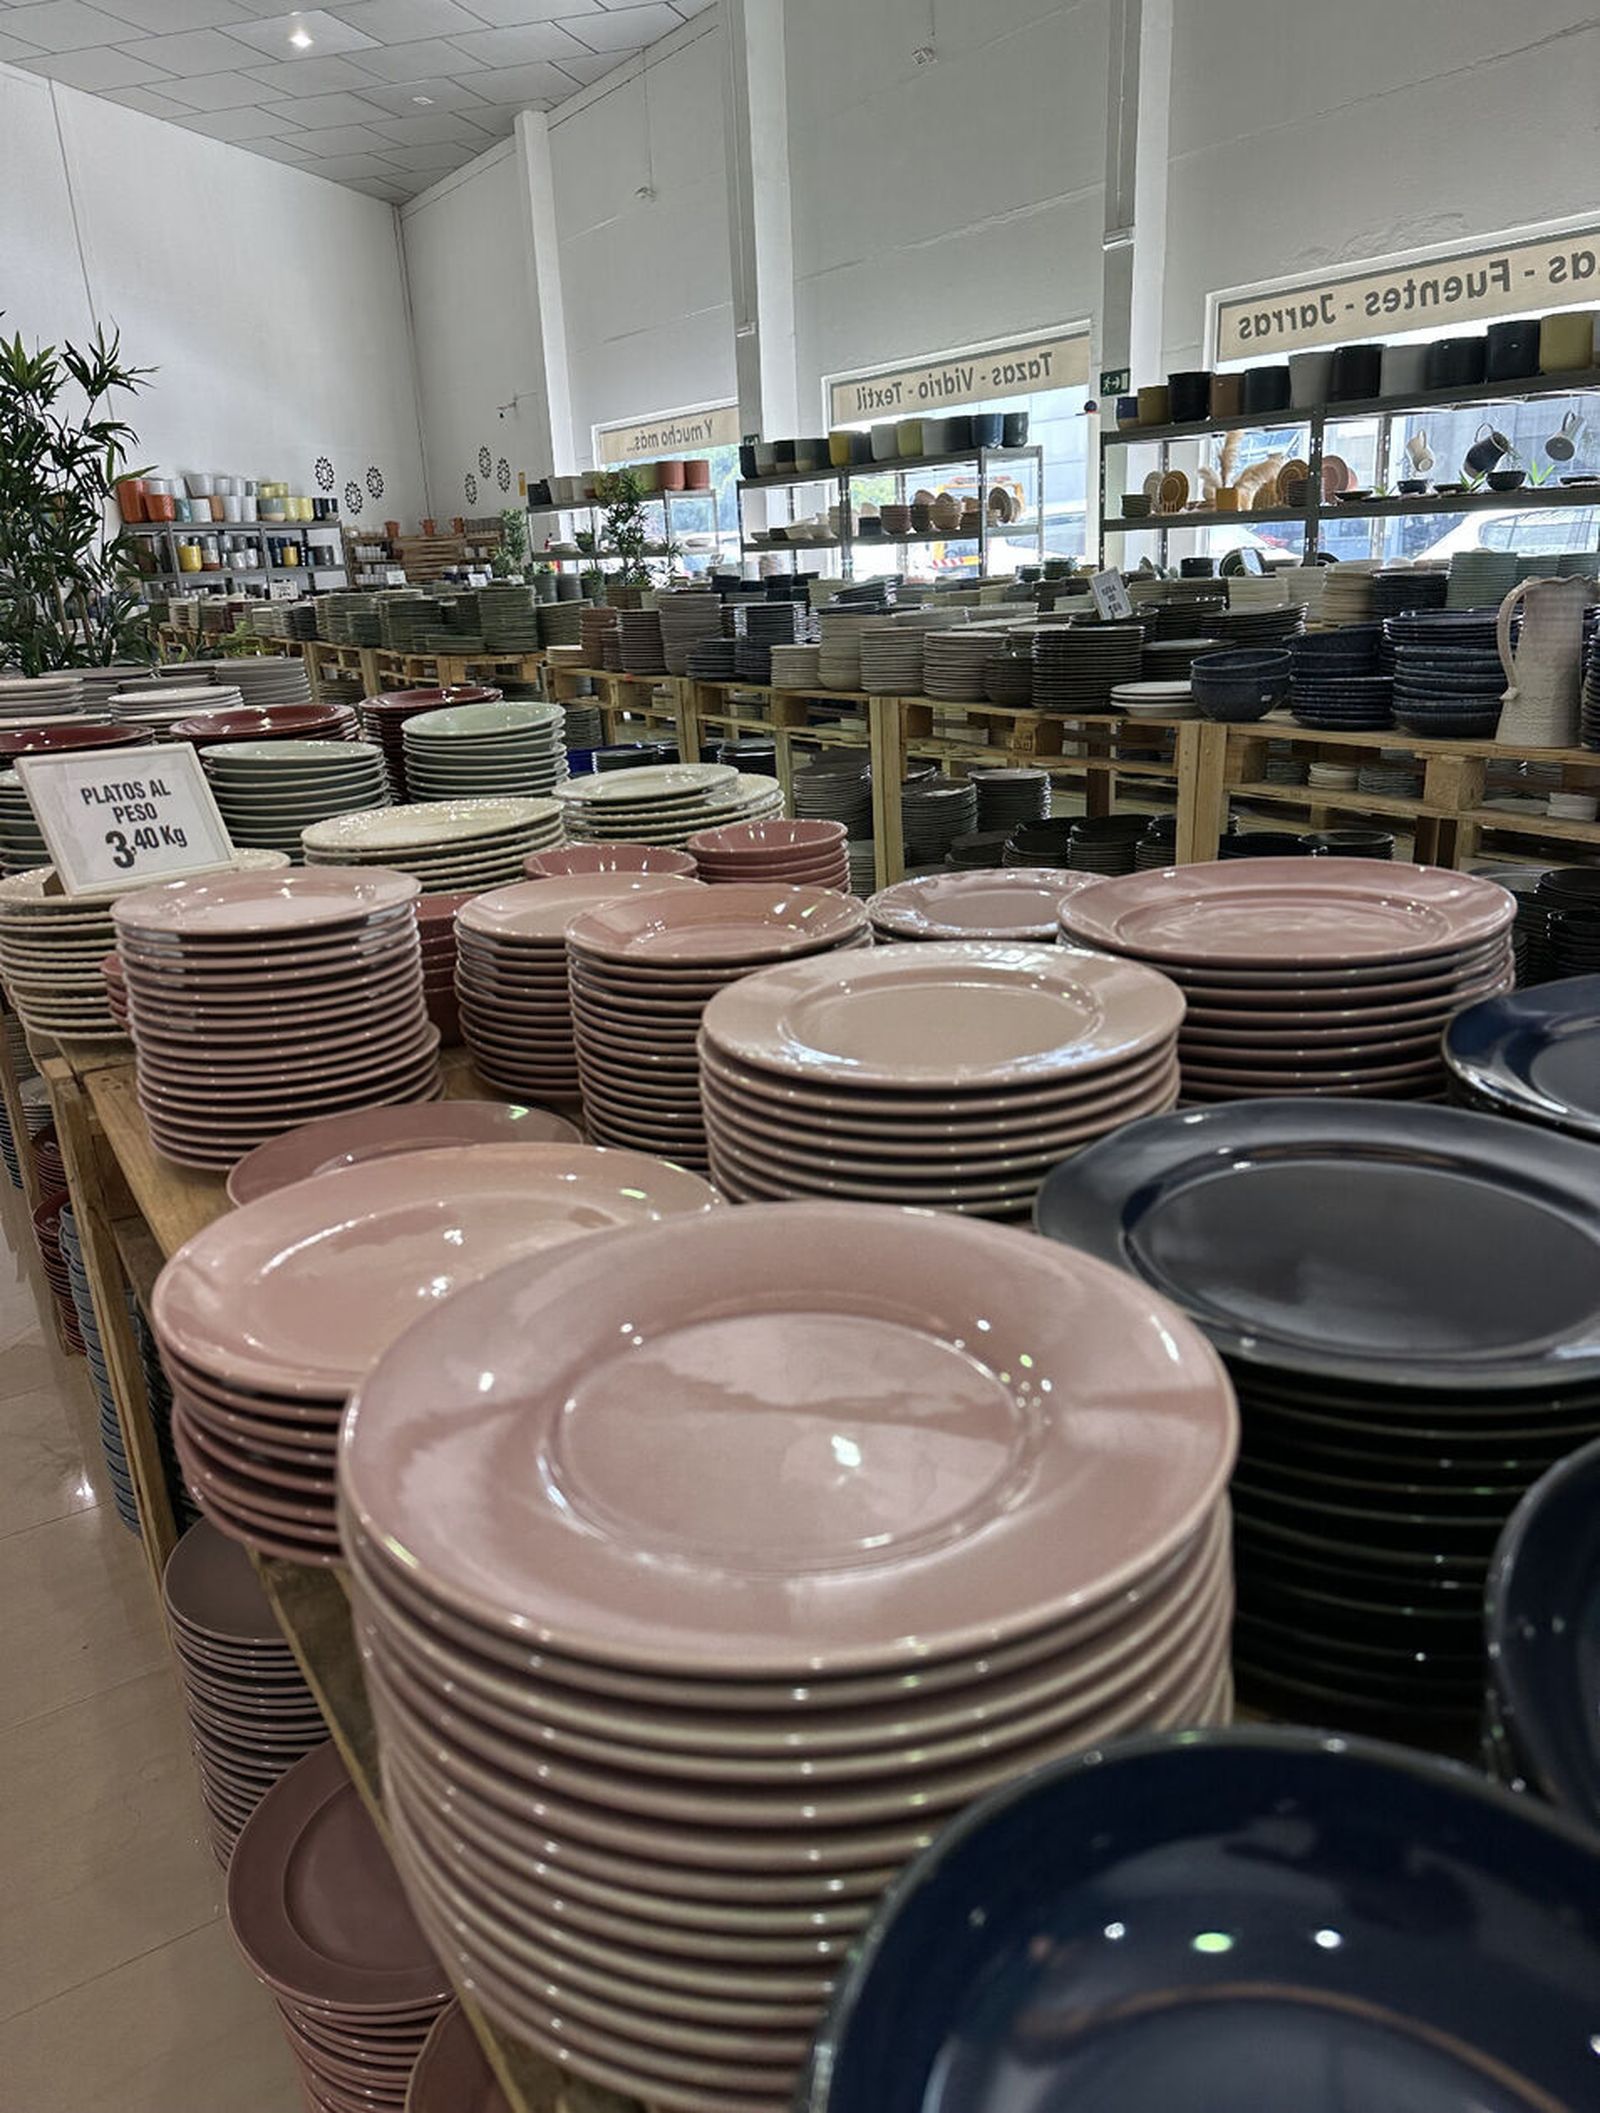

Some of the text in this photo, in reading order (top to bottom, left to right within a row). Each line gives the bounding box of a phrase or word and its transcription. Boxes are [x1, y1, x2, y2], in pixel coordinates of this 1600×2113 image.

[80, 779, 171, 805] PLATOS AL
[112, 802, 157, 823] PESO
[105, 825, 187, 868] 3,40 Kg
